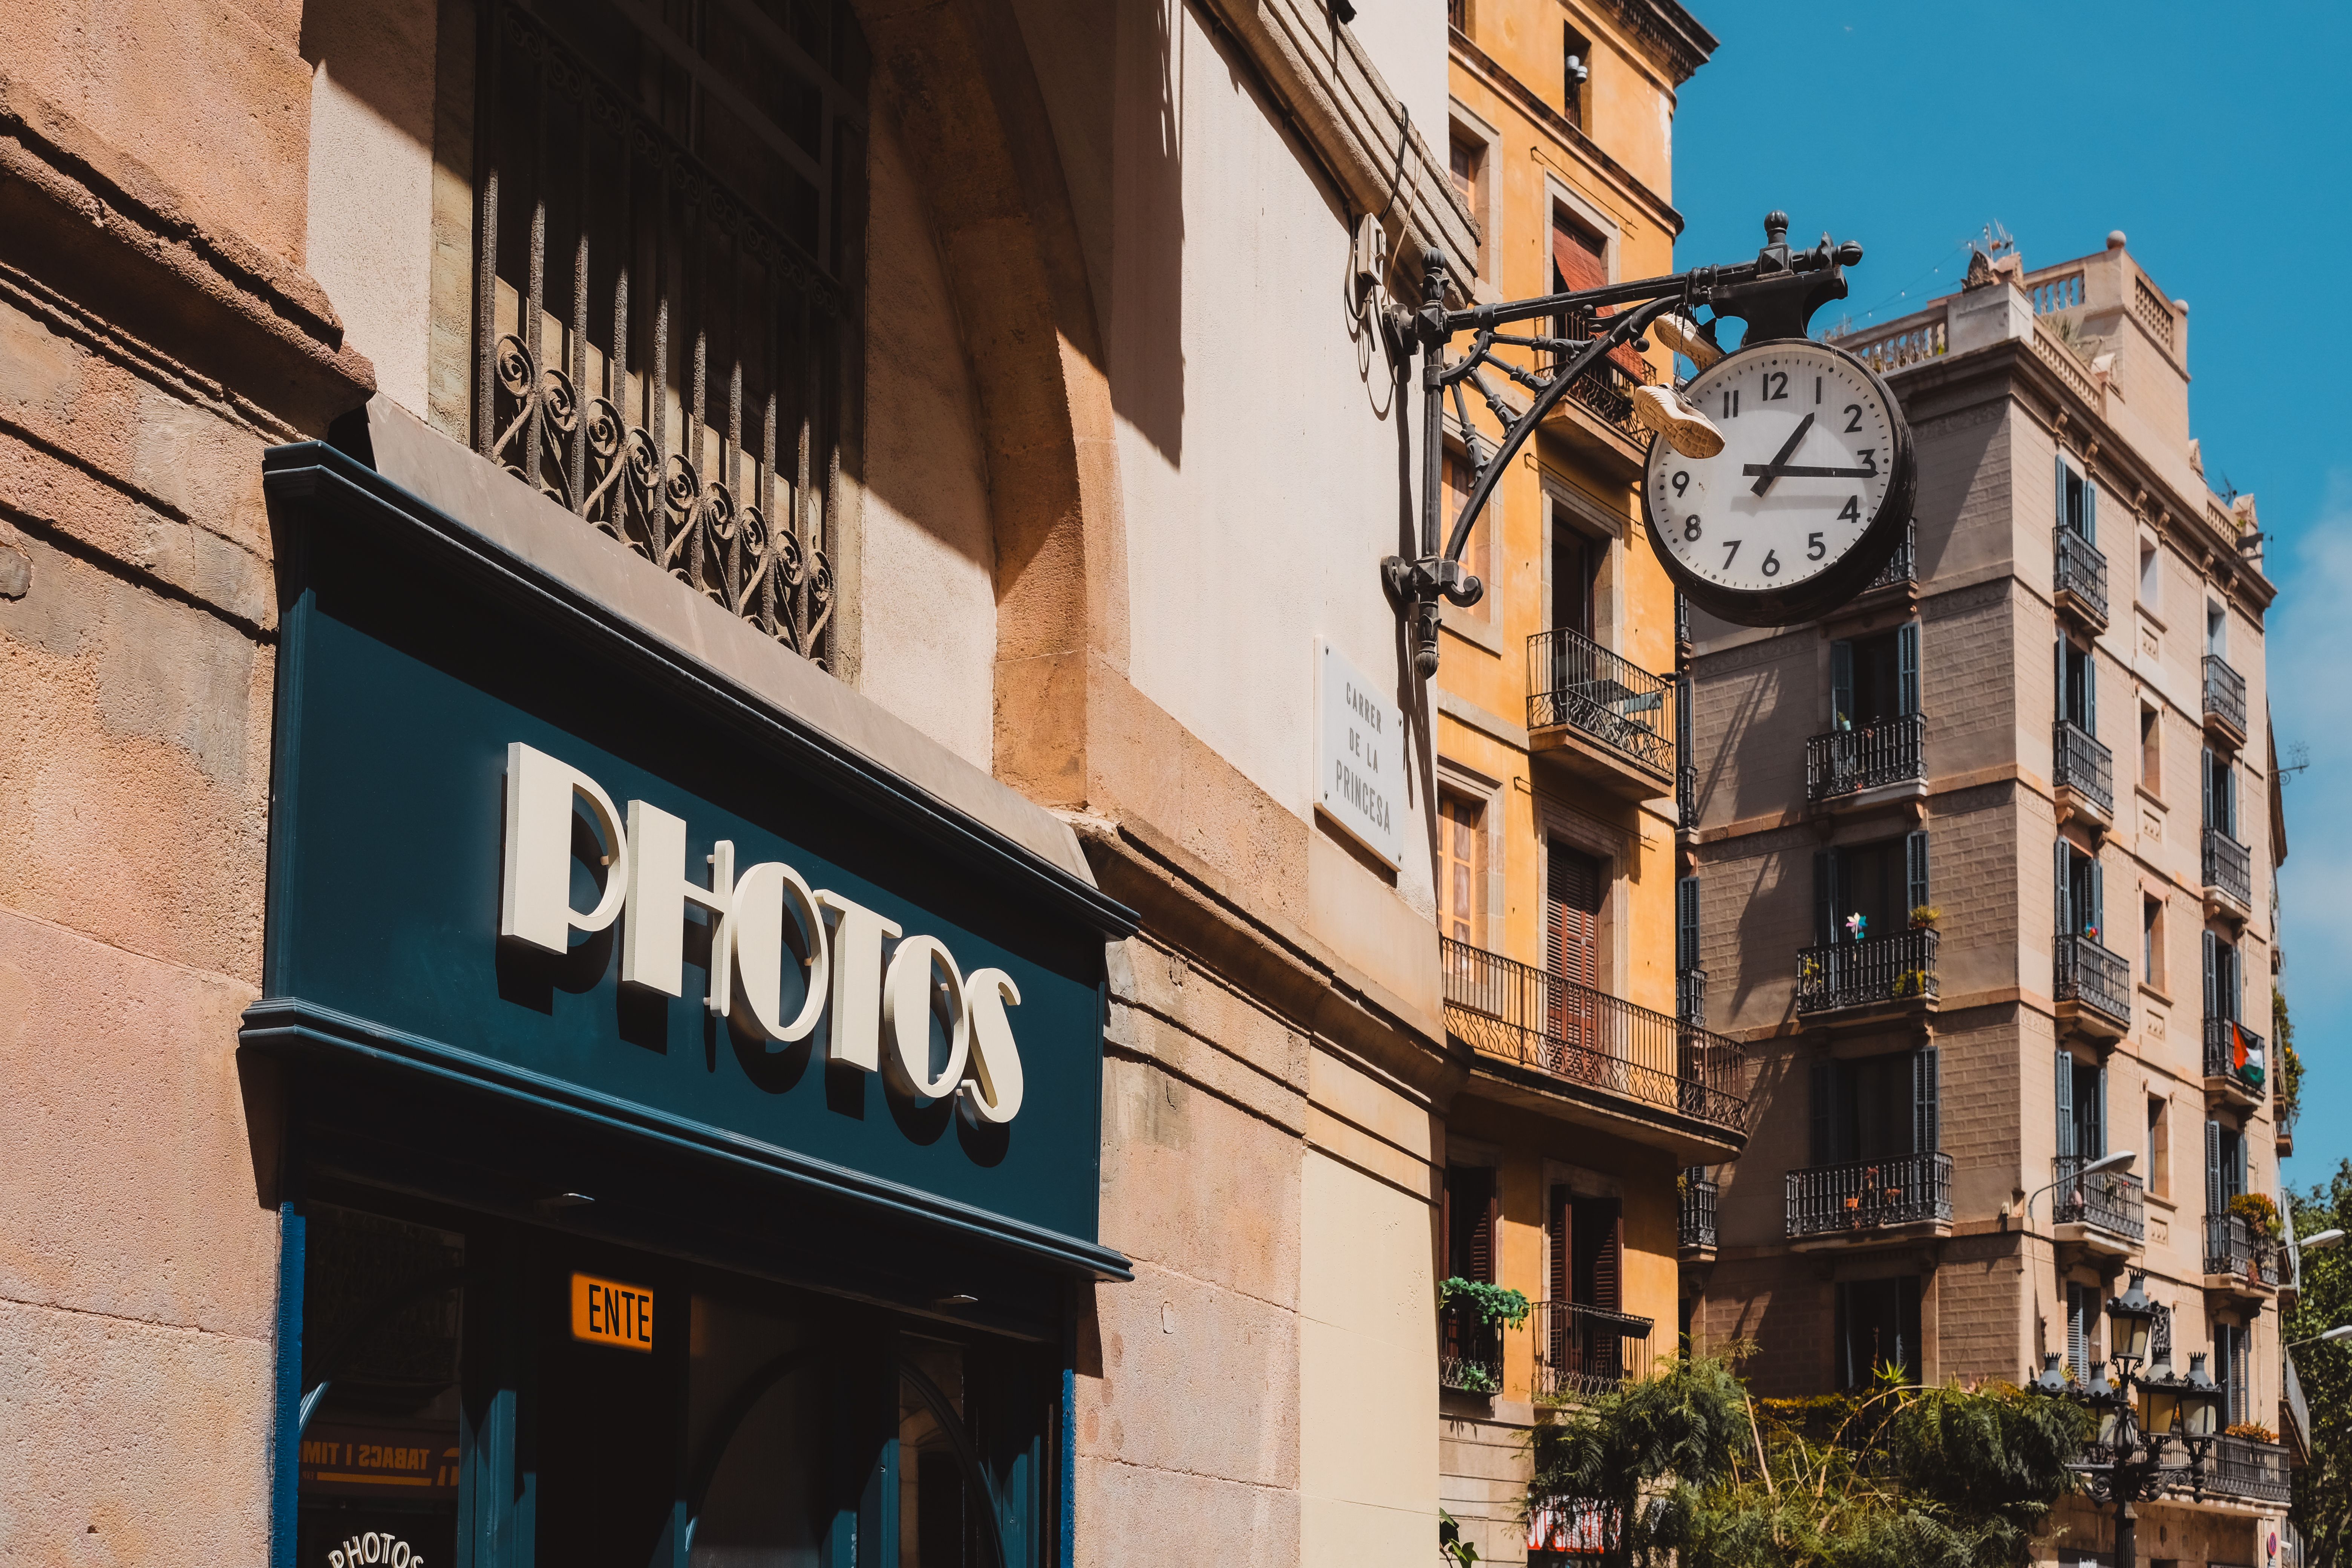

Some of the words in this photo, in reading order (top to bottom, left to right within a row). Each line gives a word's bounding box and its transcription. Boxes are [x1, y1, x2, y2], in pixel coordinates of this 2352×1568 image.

[1762, 372, 1788, 401] 12
[1815, 377, 1822, 404] 1
[1723, 390, 1739, 419] 11
[1843, 404, 1862, 433] 2
[1857, 449, 1877, 471] 3
[1671, 470, 1690, 498] 9
[1836, 495, 1861, 524] 4
[1683, 514, 1702, 542] 8
[1722, 540, 1742, 570] 7
[1806, 532, 1826, 561] 5
[1761, 549, 1780, 577] 6
[1346, 681, 1381, 735] CARRER
[1349, 727, 1360, 758] DE
[1367, 742, 1379, 774] LA
[1336, 759, 1391, 836] PRINCESA
[502, 742, 1024, 1123] PHOTOS
[589, 1283, 651, 1343] ENTE
